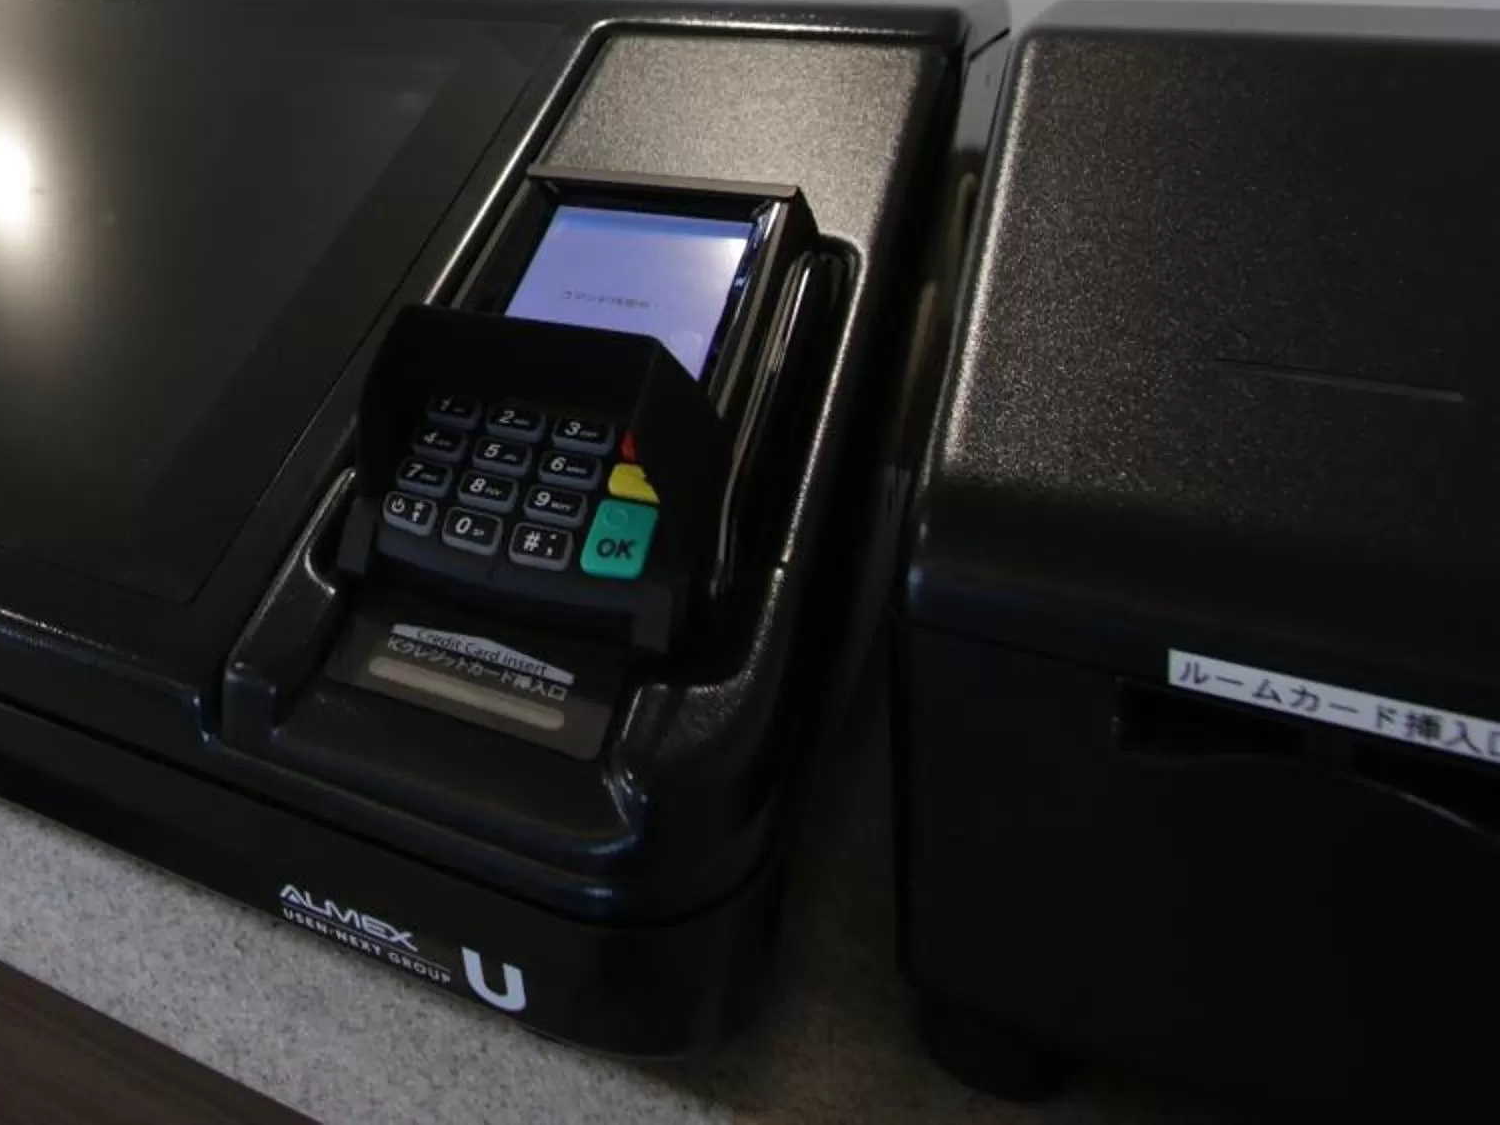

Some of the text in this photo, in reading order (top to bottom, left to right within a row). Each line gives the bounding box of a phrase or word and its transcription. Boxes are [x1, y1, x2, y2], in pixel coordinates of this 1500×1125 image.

[499, 410, 515, 424] 2
[564, 421, 581, 436] 3
[484, 443, 500, 458] 5
[405, 463, 424, 478] 7
[550, 456, 566, 472] 6
[469, 478, 486, 494] 8
[534, 491, 552, 507] 9
[455, 516, 473, 535] 0
[596, 537, 638, 560] OK
[416, 629, 460, 652] Credit
[464, 642, 498, 663] Card
[279, 883, 419, 953] ALMEX
[388, 951, 451, 984] GROUP
[461, 946, 528, 1012] U
